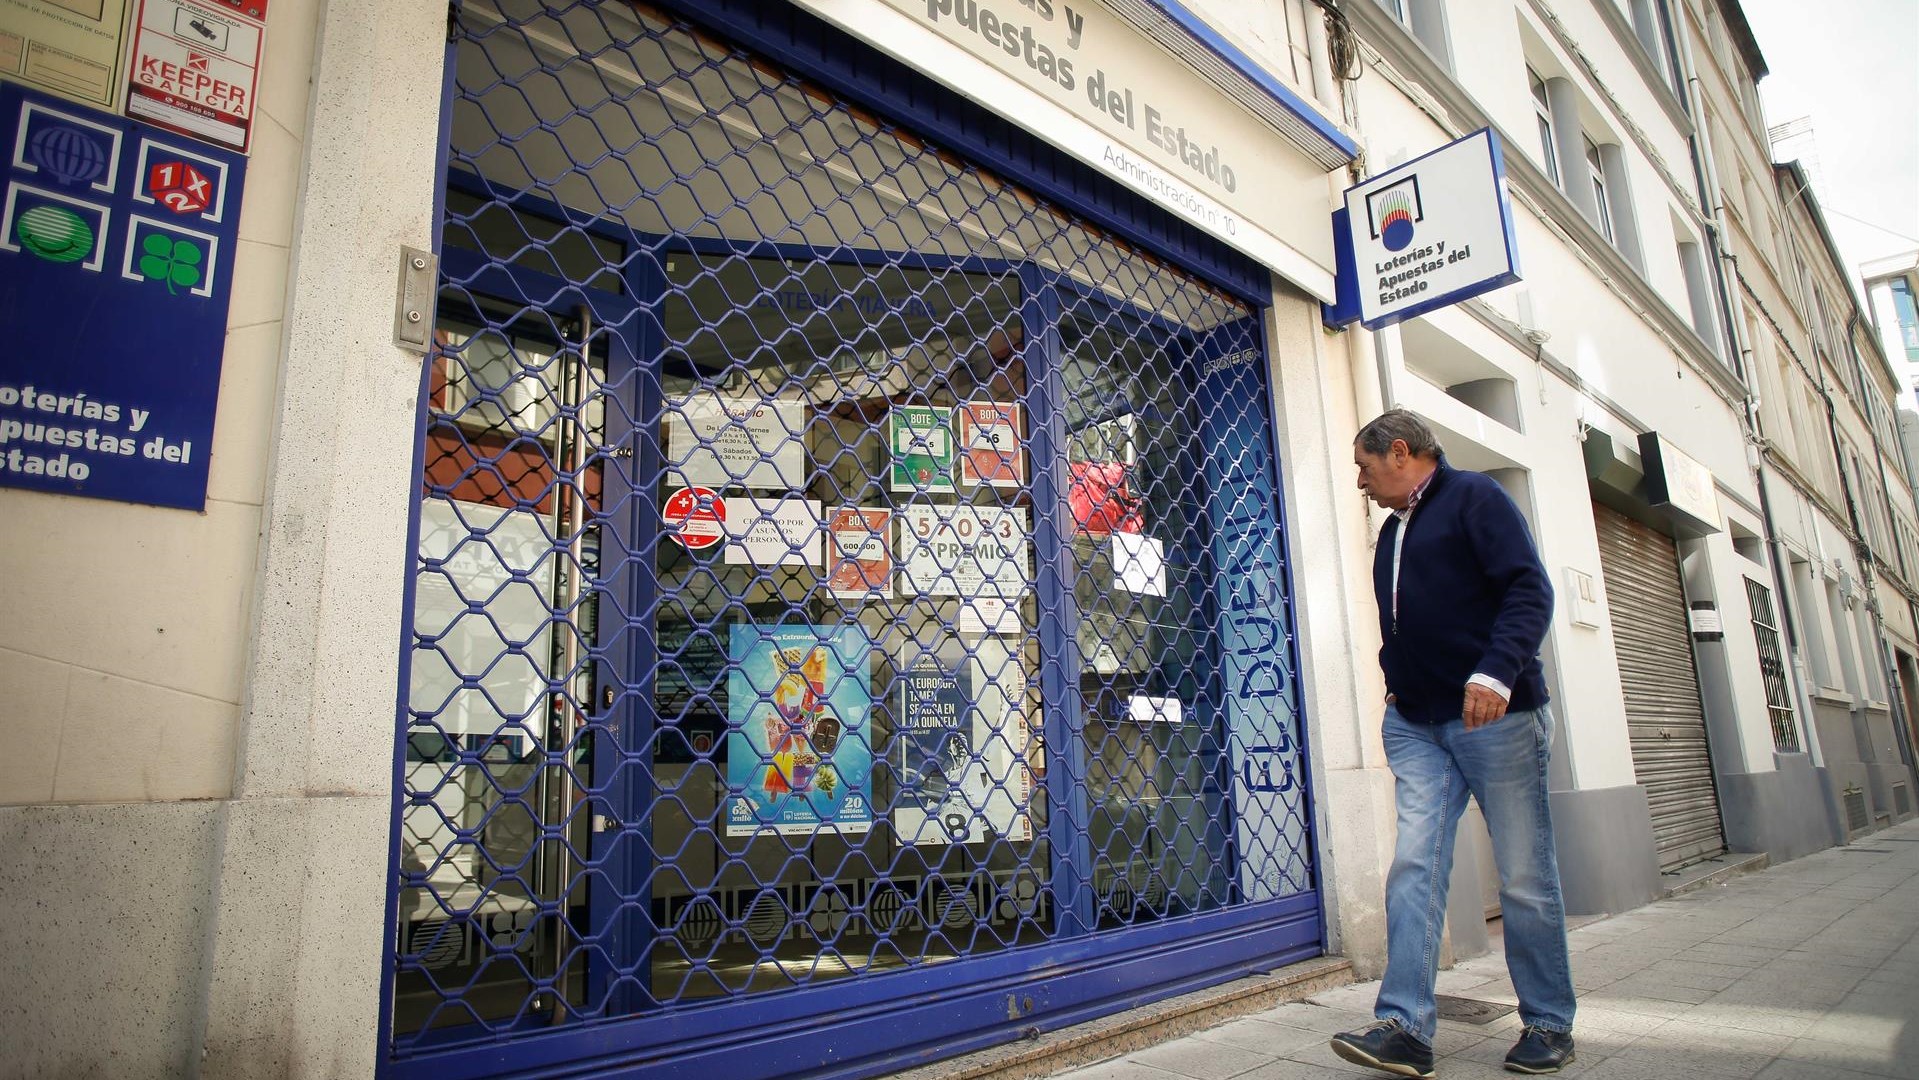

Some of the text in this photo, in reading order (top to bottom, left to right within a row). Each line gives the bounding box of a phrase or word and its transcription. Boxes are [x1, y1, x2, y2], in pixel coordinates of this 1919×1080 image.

[186, 3, 242, 29] VIDEOVIGILADA
[1064, 5, 1084, 51] y
[139, 72, 245, 116] GALICIA
[141, 54, 246, 105] KEEPER
[921, 0, 1237, 194] puestas del Estado
[1103, 145, 1206, 219] Administración
[1223, 215, 1237, 236] 10
[1375, 240, 1446, 276] Loterías y
[1378, 244, 1471, 291] Apuestas del
[1379, 279, 1429, 306] Estado
[0, 385, 150, 432] oterías y
[910, 413, 932, 425] BOTE
[0, 418, 192, 465] puestas del
[723, 447, 752, 455] Sábados
[0, 449, 91, 481] tado
[743, 518, 785, 526] CERRAO
[755, 527, 793, 535] ASUNOS
[745, 536, 802, 544] PERSONES.
[944, 703, 955, 715] EN
[844, 797, 863, 809] 20
